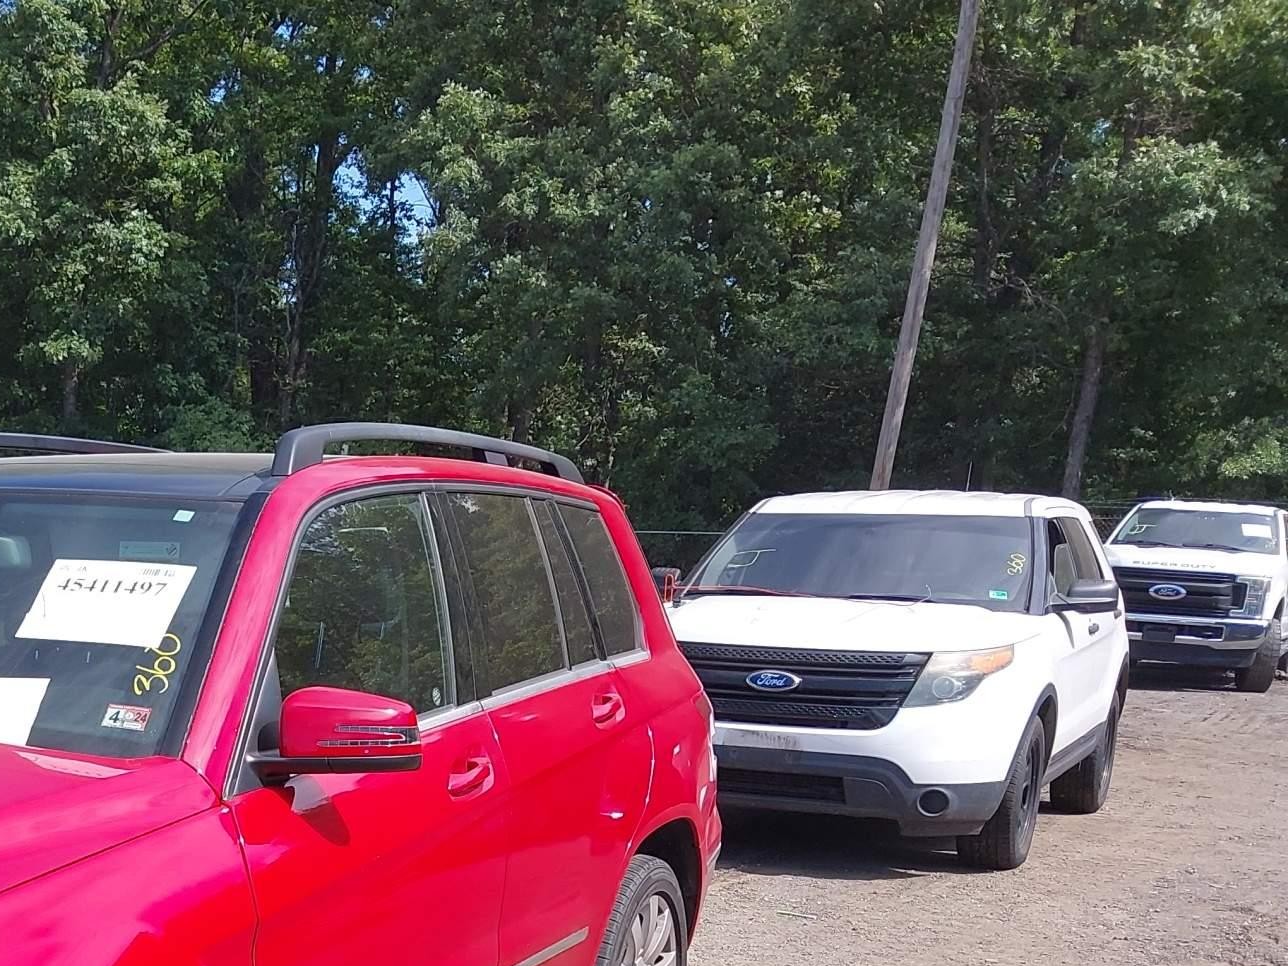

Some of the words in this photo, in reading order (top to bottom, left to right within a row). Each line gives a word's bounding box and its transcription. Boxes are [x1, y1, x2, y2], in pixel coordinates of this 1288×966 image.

[57, 577, 168, 596] 45411497
[756, 673, 787, 686] Ford
[109, 710, 120, 723] 4
[135, 710, 148, 723] 24
